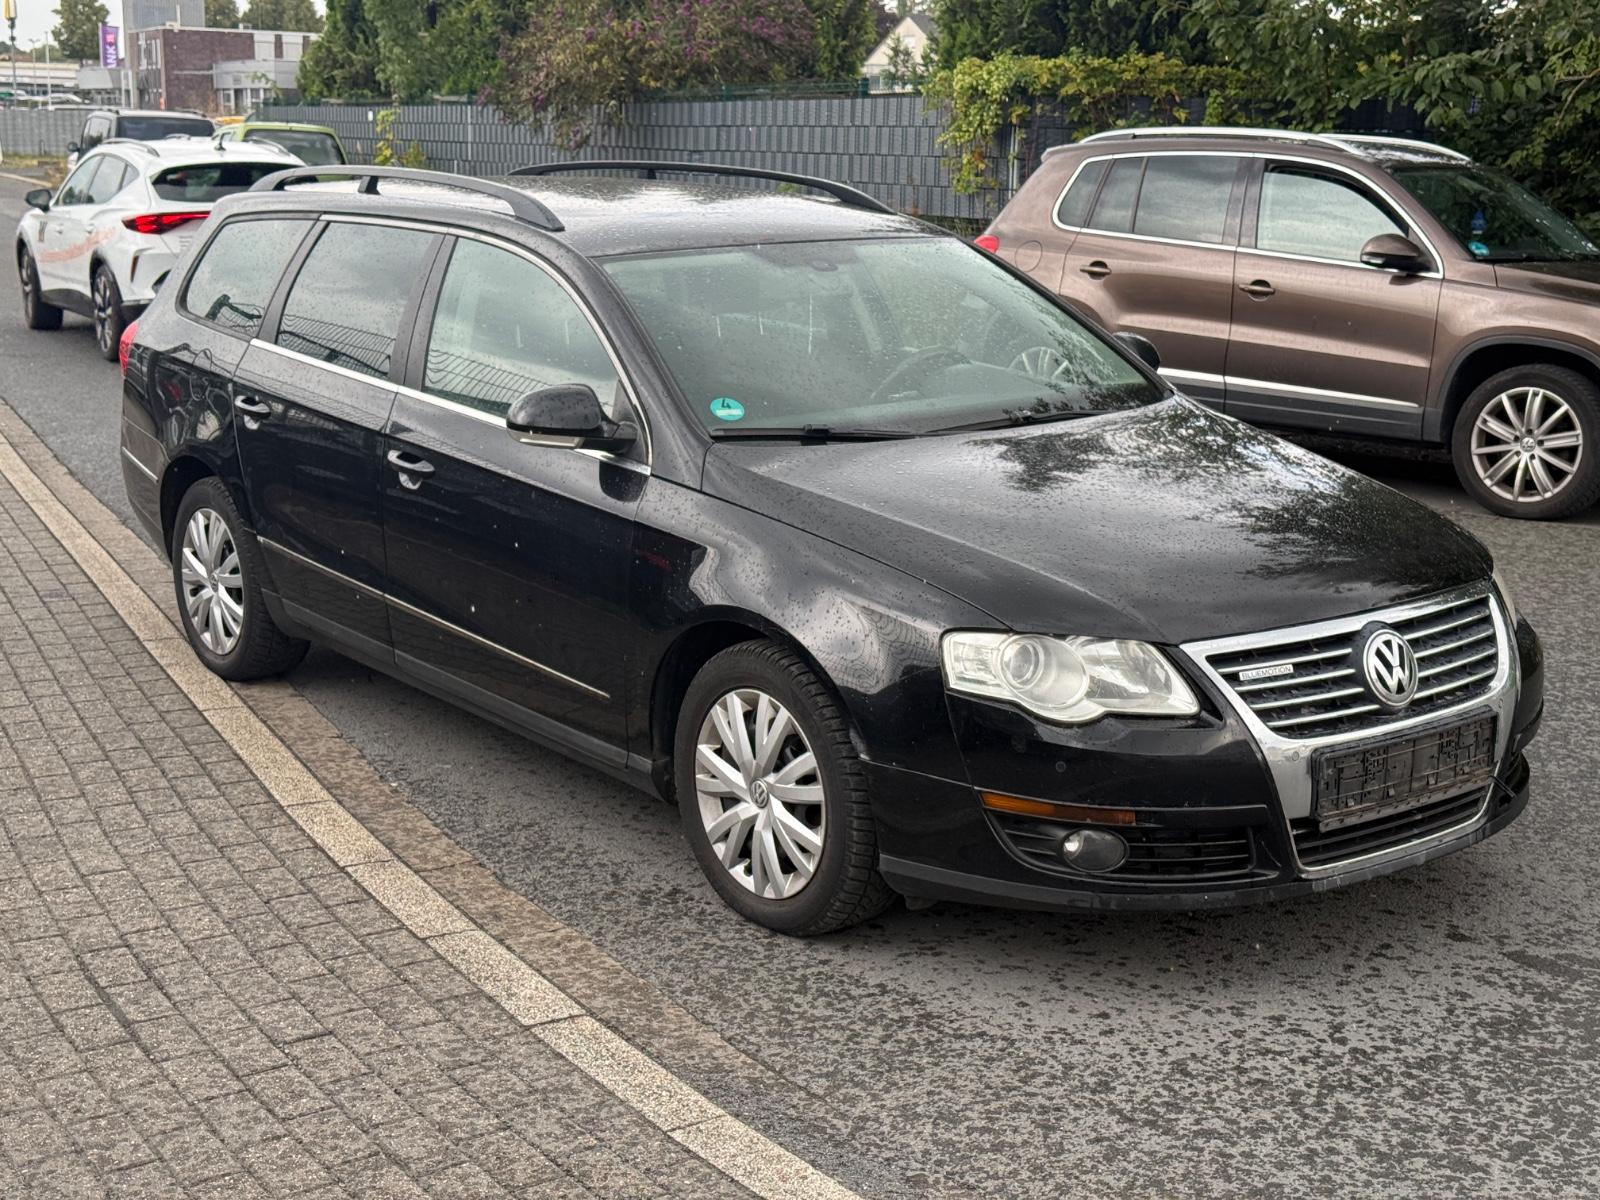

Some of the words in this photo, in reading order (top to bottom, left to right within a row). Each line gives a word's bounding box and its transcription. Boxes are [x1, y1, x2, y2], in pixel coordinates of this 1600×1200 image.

[721, 398, 732, 409] 4
[1241, 665, 1292, 680] BLUEMOTION
[1365, 631, 1417, 704] VW
